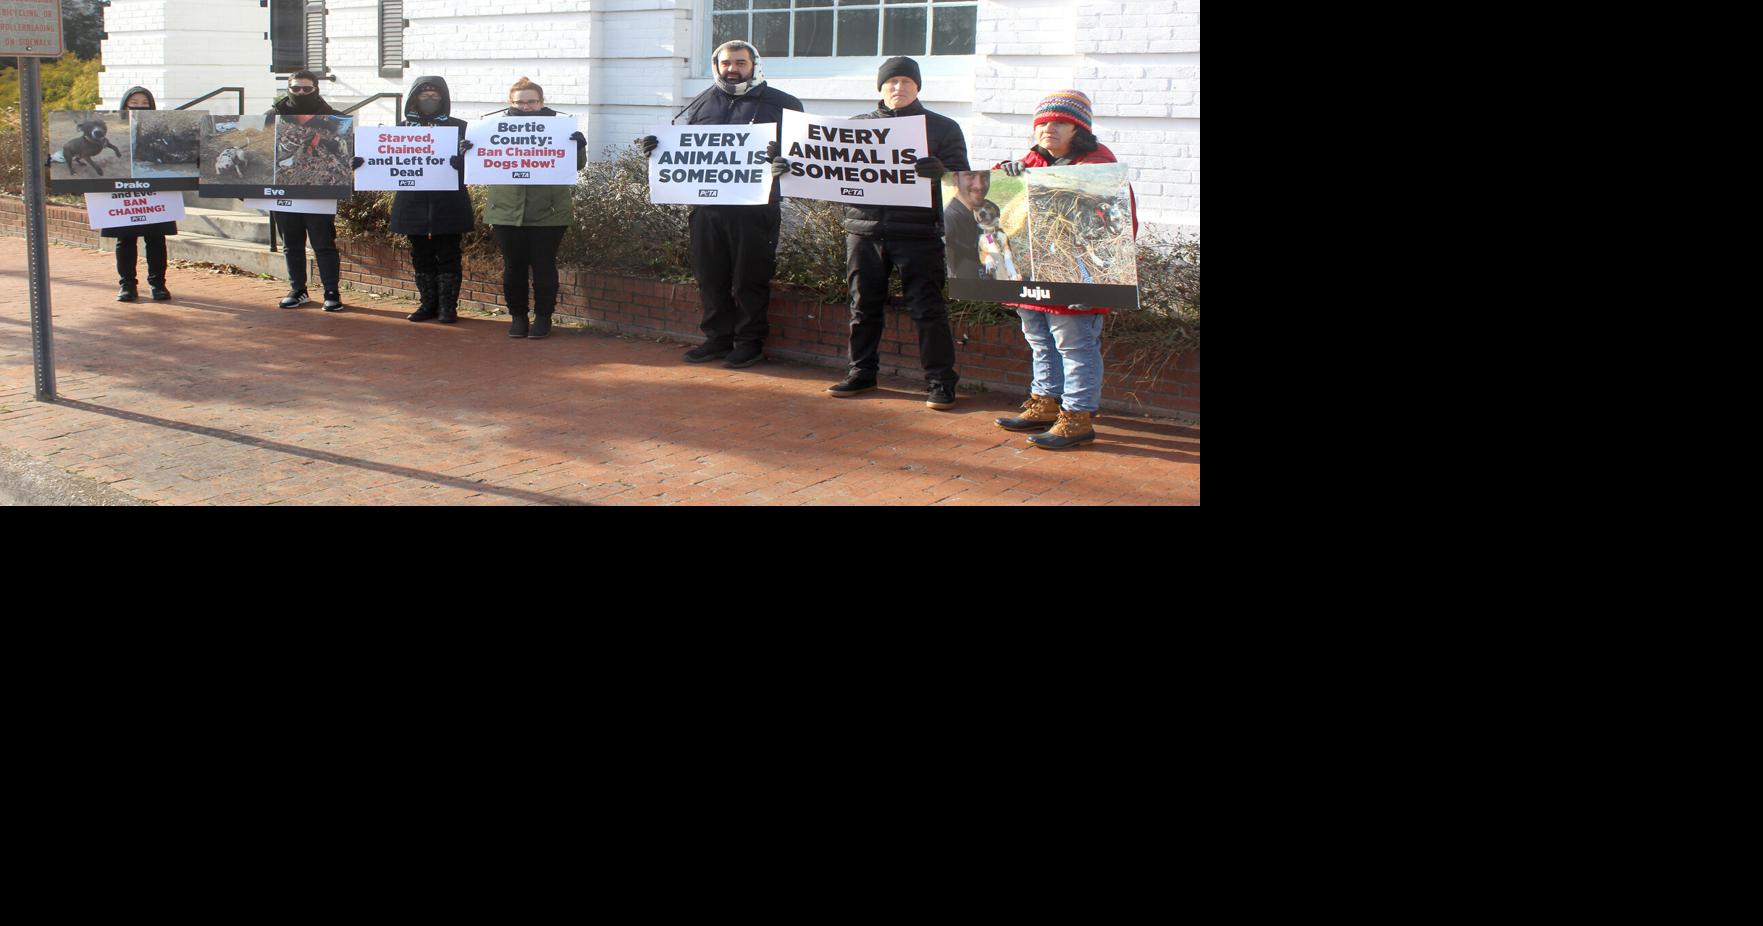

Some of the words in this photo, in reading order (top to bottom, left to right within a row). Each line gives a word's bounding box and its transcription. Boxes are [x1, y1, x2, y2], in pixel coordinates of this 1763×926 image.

[5, 38, 16, 46] ON
[19, 38, 51, 46] SIDEWALK
[497, 122, 546, 133] Bertie
[378, 133, 435, 144] Starved,
[679, 133, 751, 147] EVERY
[808, 124, 891, 145] EVERY
[490, 134, 553, 147] County:
[378, 145, 435, 155] Chained,
[477, 147, 502, 157] Ban
[505, 147, 566, 158] Chaining
[788, 141, 885, 164] ANIMAL
[891, 148, 918, 165] IS
[368, 156, 393, 165] and
[396, 156, 423, 165] Left
[425, 156, 446, 165] for
[657, 151, 742, 165] ANIMAL
[746, 151, 767, 165] IS
[483, 159, 518, 169] Dogs
[520, 159, 556, 168] Now!
[390, 168, 424, 177] Dead
[658, 169, 764, 183] SOMEONE
[790, 161, 916, 184] SOMEONE
[114, 181, 151, 189] Drako
[111, 191, 131, 199] and
[263, 187, 285, 196] Eve
[123, 198, 148, 207] BAN
[108, 204, 166, 216] CHAINING!
[1019, 286, 1051, 301] Juju
